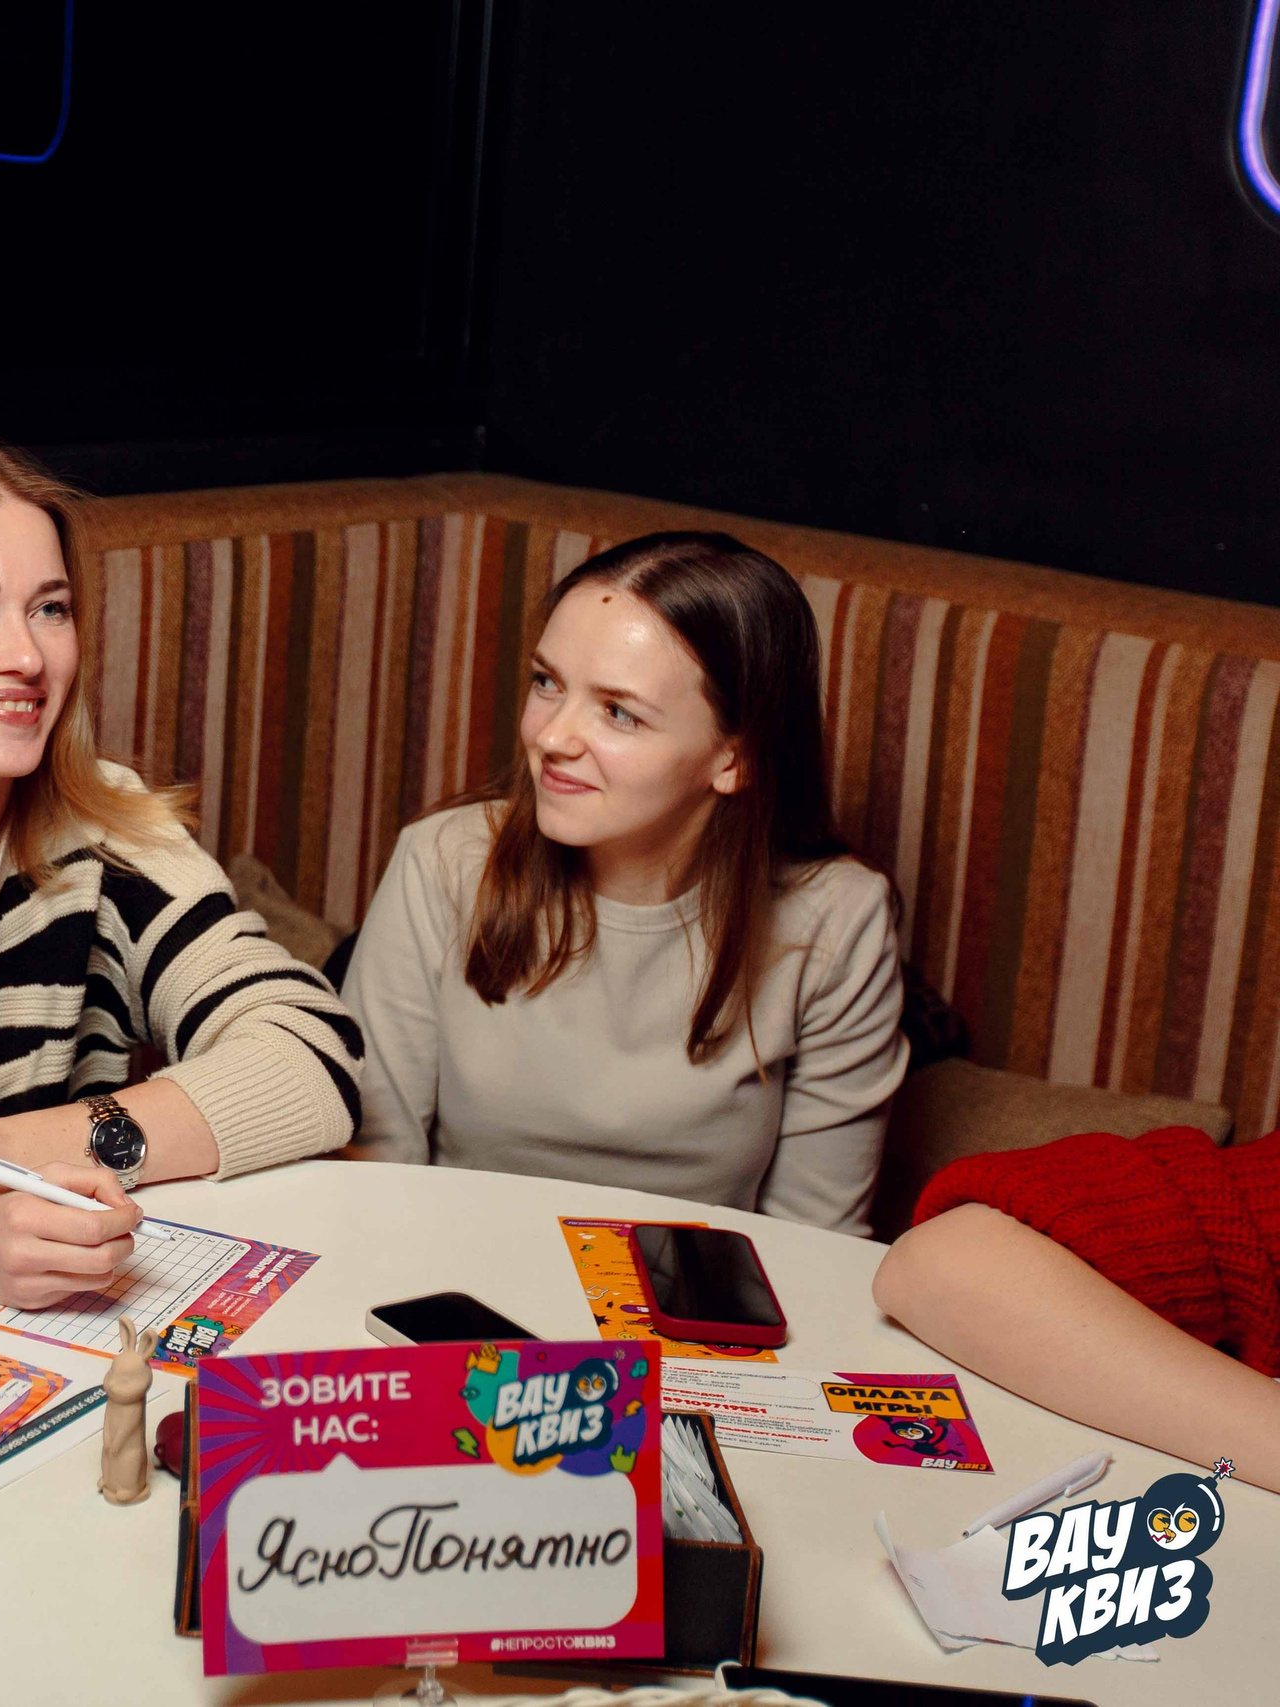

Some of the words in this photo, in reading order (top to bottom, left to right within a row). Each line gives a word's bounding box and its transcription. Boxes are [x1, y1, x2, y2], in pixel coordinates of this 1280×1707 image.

[270, 1254, 296, 1272] ВАША
[248, 1271, 278, 1294] ВЕРСИЯ
[166, 1326, 194, 1353] КВИЗ
[190, 1325, 219, 1348] ВАУ
[259, 1371, 411, 1408] ЗОВИТЕ
[493, 1373, 570, 1428] ВАУ
[827, 1386, 951, 1401] ОПЛАТА
[52, 1401, 86, 1426] УМНЫХ
[853, 1400, 932, 1414] ИГРЫ
[293, 1412, 380, 1446] НАС:
[515, 1404, 604, 1458] КВИЗ
[715, 1425, 751, 1433] ЧНЫМИ
[921, 1457, 958, 1470] ВАУ
[956, 1462, 987, 1471] КВИЗ
[490, 1635, 616, 1652] #НЕПРОСТОКВИЗ
